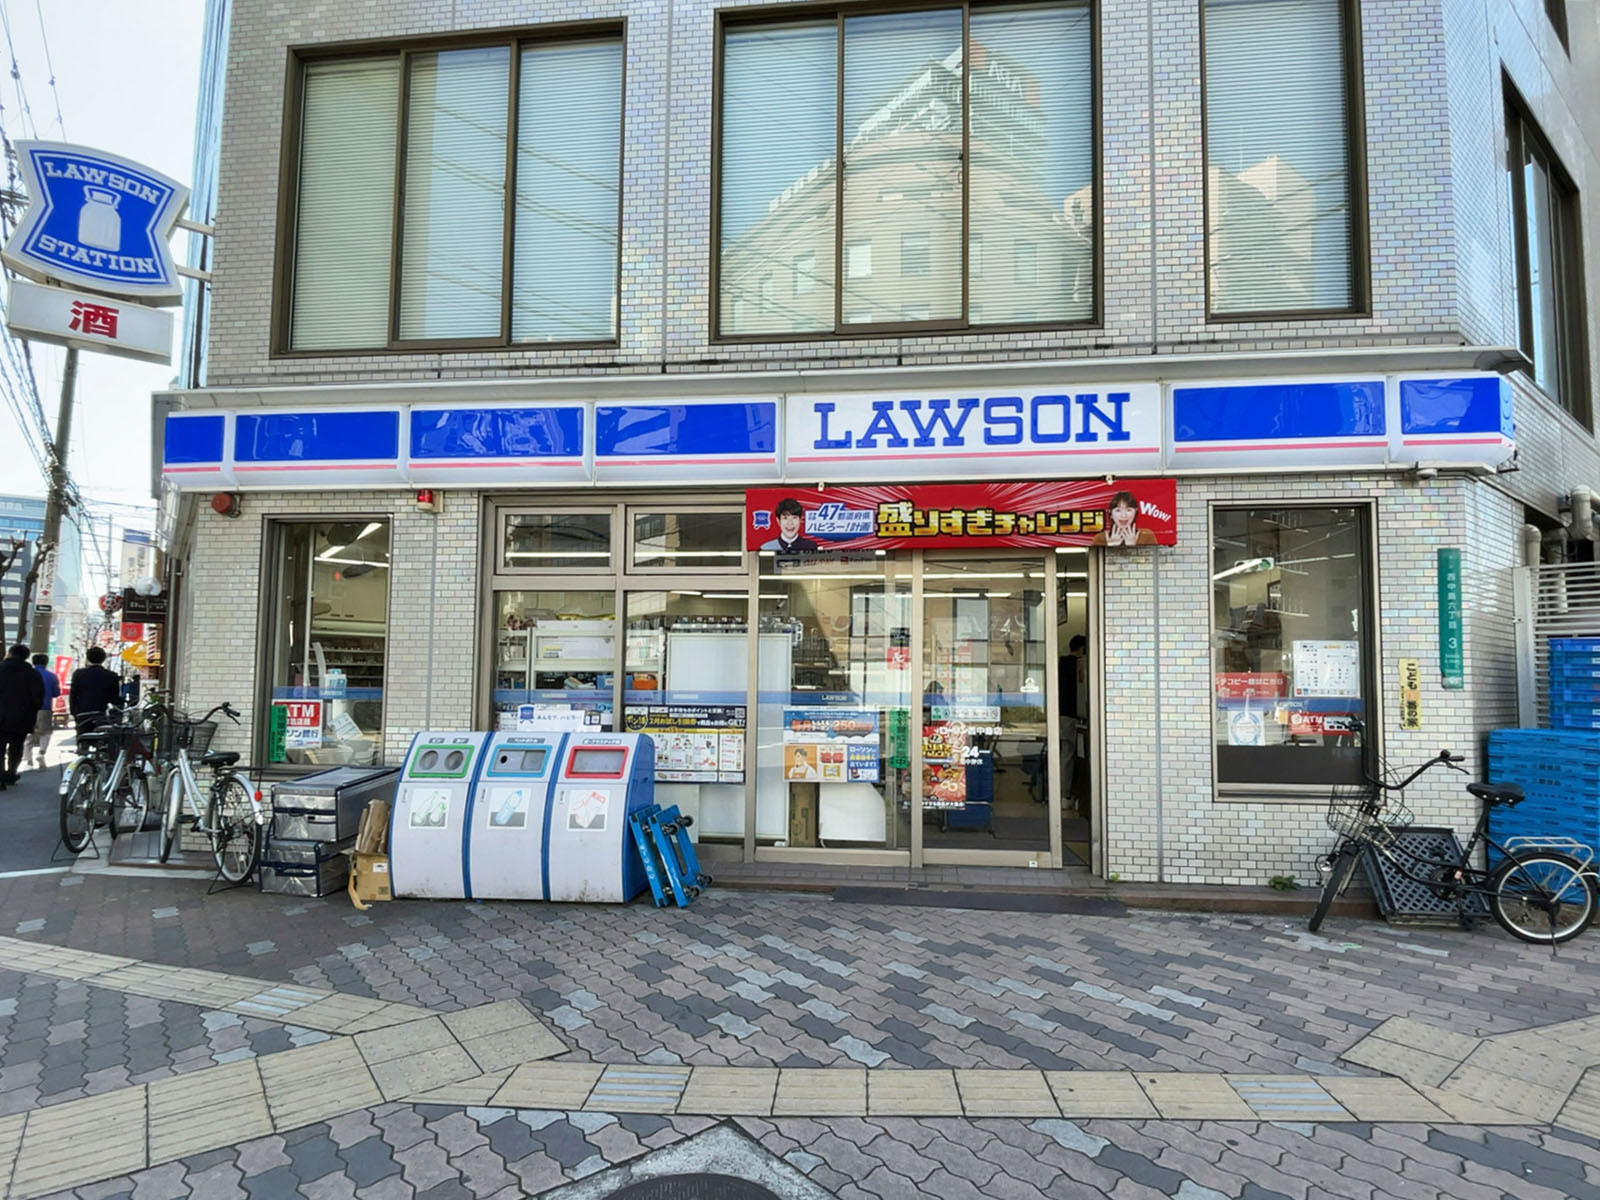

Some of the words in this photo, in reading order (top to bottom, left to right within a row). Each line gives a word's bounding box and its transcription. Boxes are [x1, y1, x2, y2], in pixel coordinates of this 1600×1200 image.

[44, 161, 161, 205] LAWSON
[38, 234, 157, 274] STATION
[69, 300, 120, 339] 酒
[813, 392, 1131, 450] LAWSON
[878, 502, 1104, 536] 盛りすぎチャレンジ
[1448, 637, 1458, 649] 3
[1406, 662, 1420, 728] こども番の家
